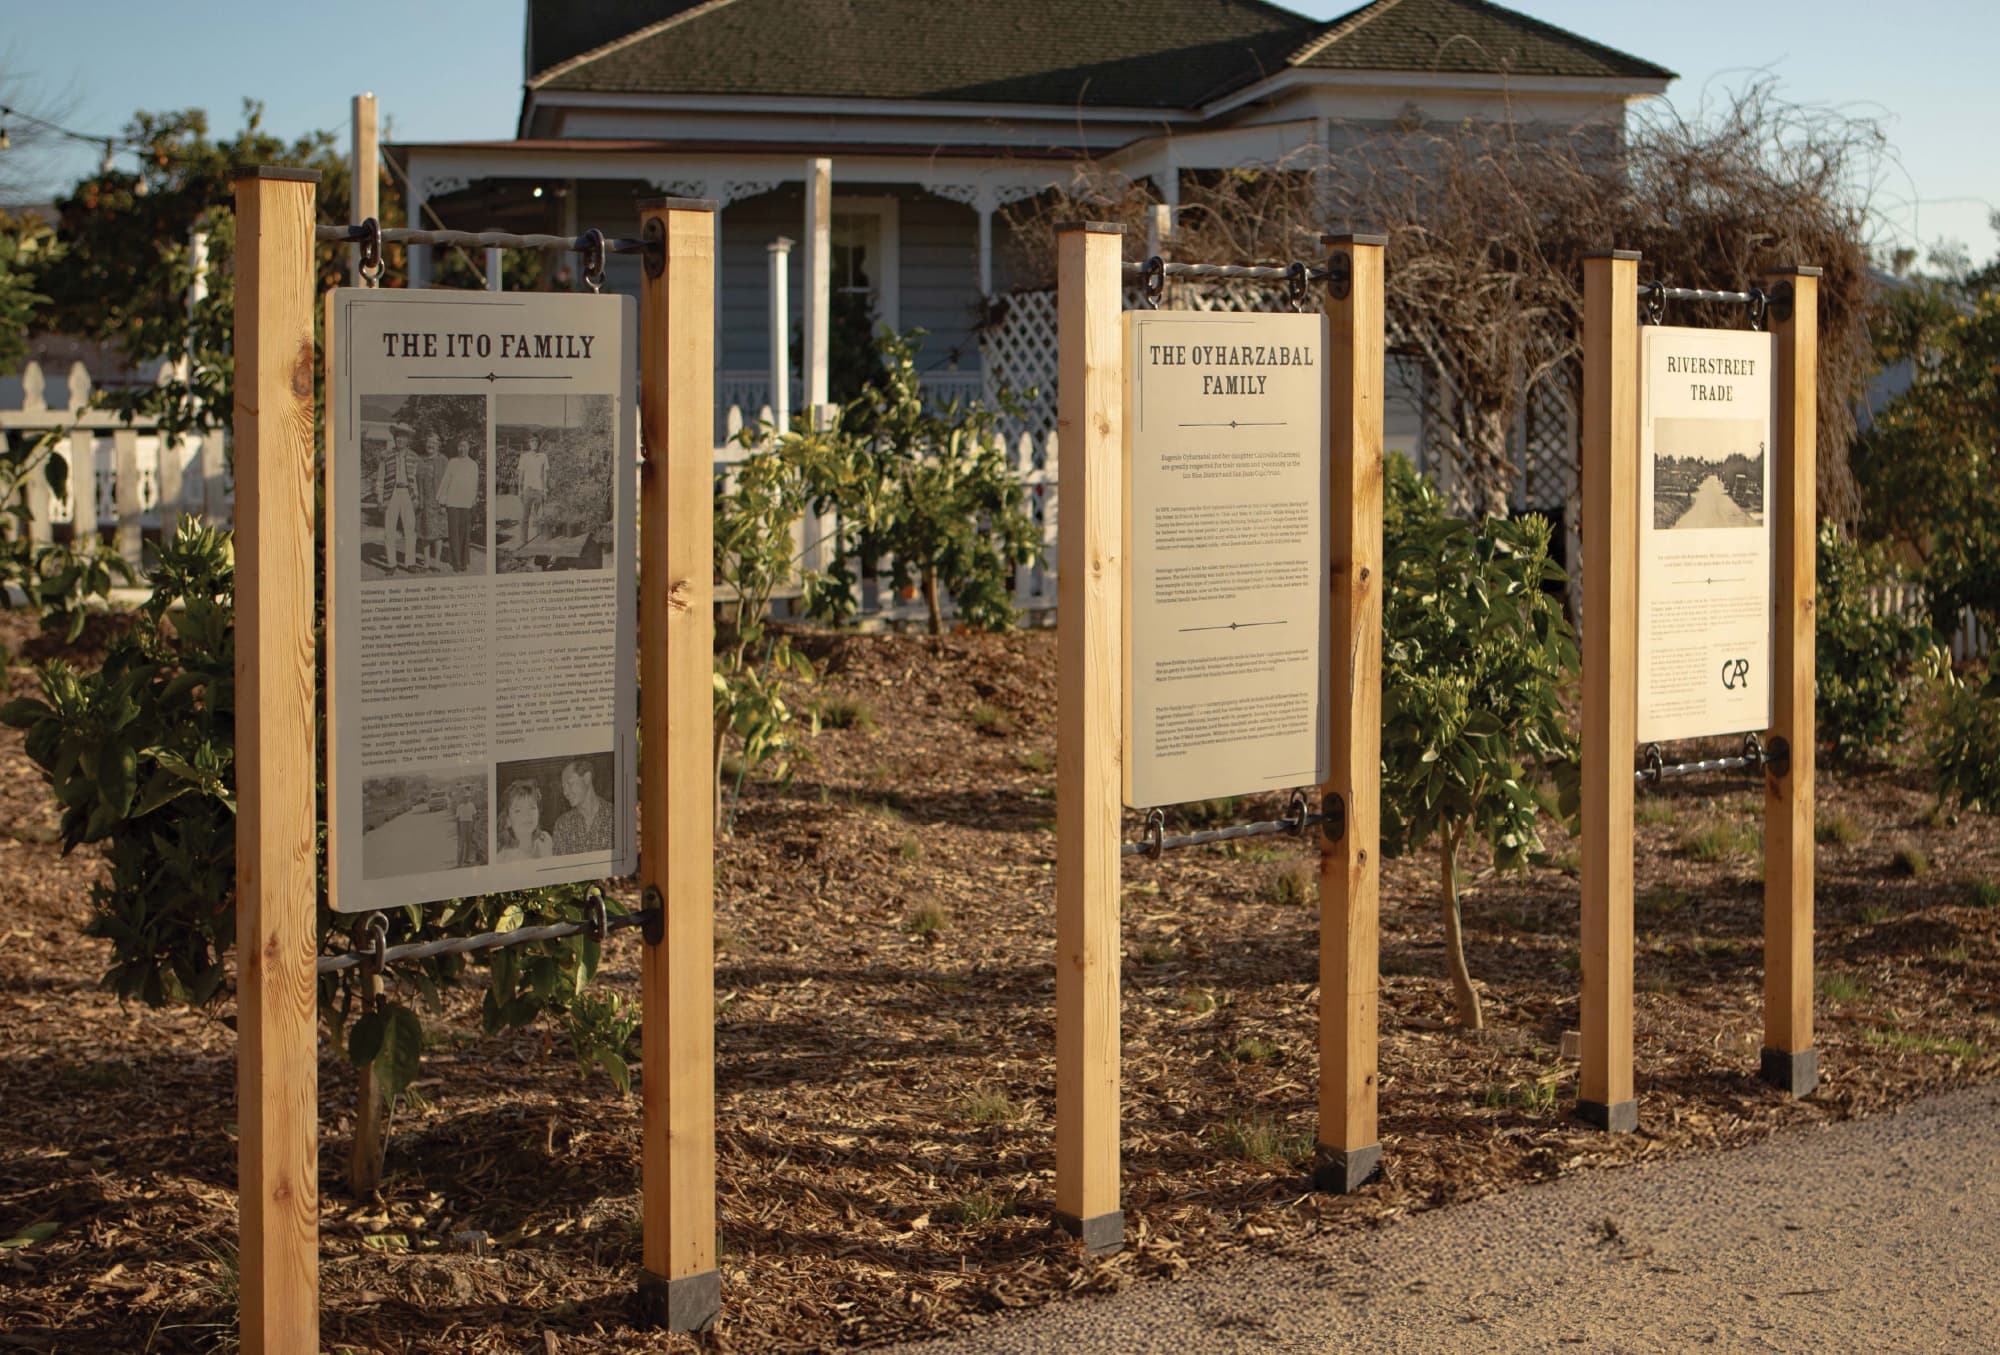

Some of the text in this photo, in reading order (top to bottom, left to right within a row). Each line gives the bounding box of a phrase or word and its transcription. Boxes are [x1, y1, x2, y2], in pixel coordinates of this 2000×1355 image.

[382, 332, 595, 359] THE ITO FAMILY
[1150, 345, 1314, 366] THE OYHARZABAL
[1667, 355, 1755, 376] RIVERSTREET
[1202, 375, 1267, 395] FAMILY
[1690, 384, 1733, 402] TRADE
